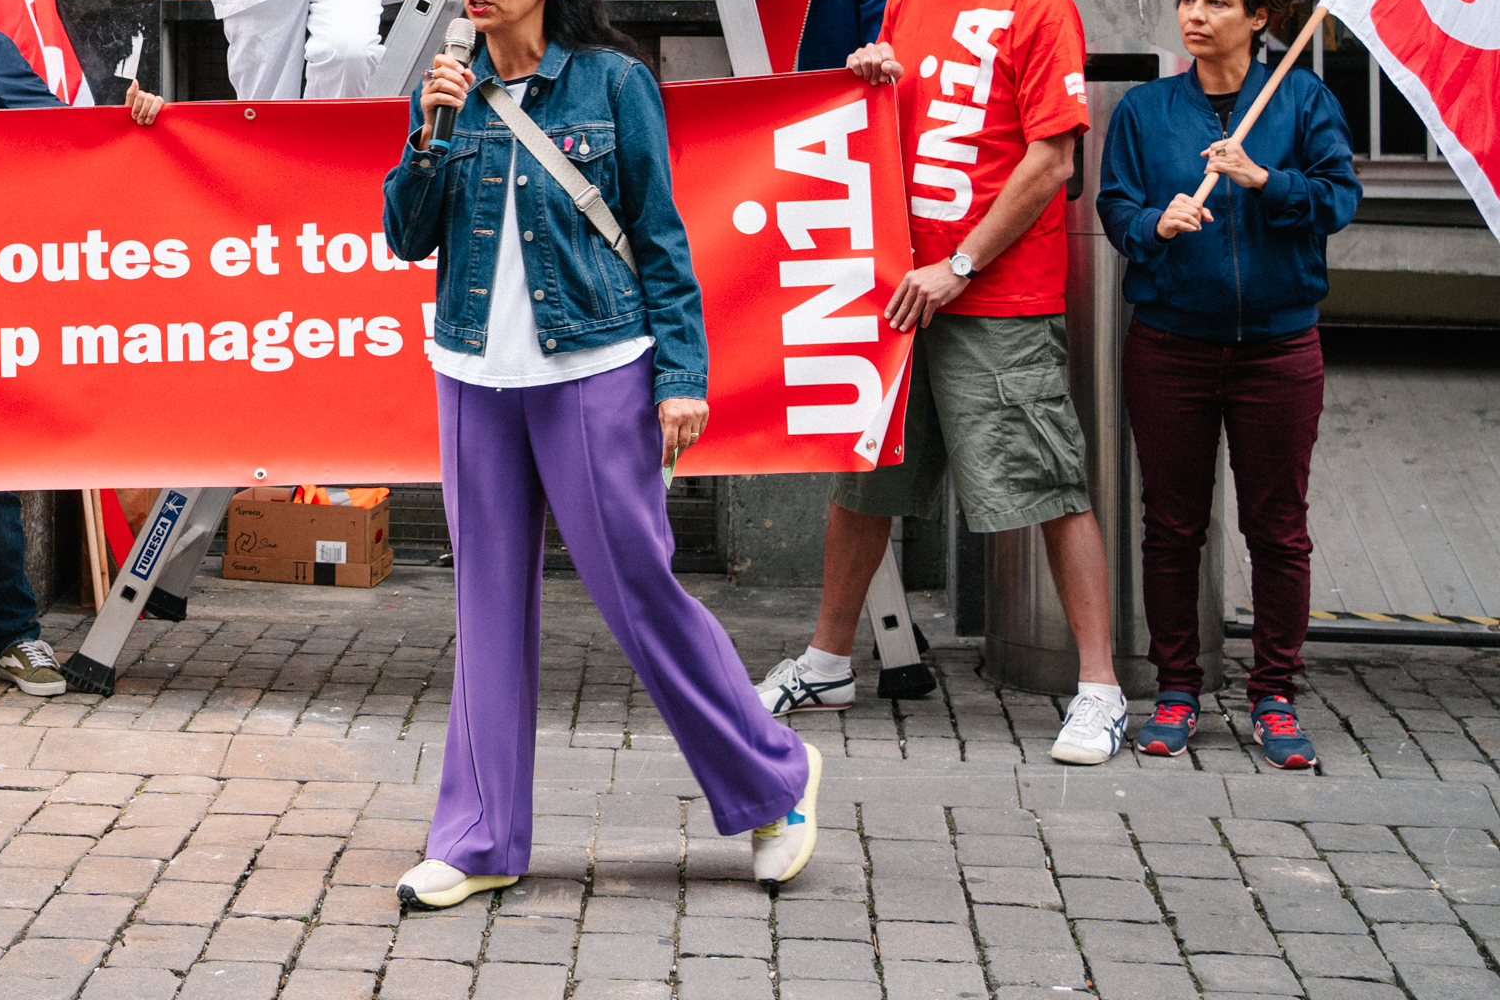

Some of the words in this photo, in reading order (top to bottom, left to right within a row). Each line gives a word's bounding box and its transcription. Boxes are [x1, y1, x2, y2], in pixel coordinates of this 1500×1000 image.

[210, 224, 279, 277] et
[296, 222, 438, 274] tou
[61, 311, 403, 373] managers
[138, 521, 169, 571] TUBESCA
